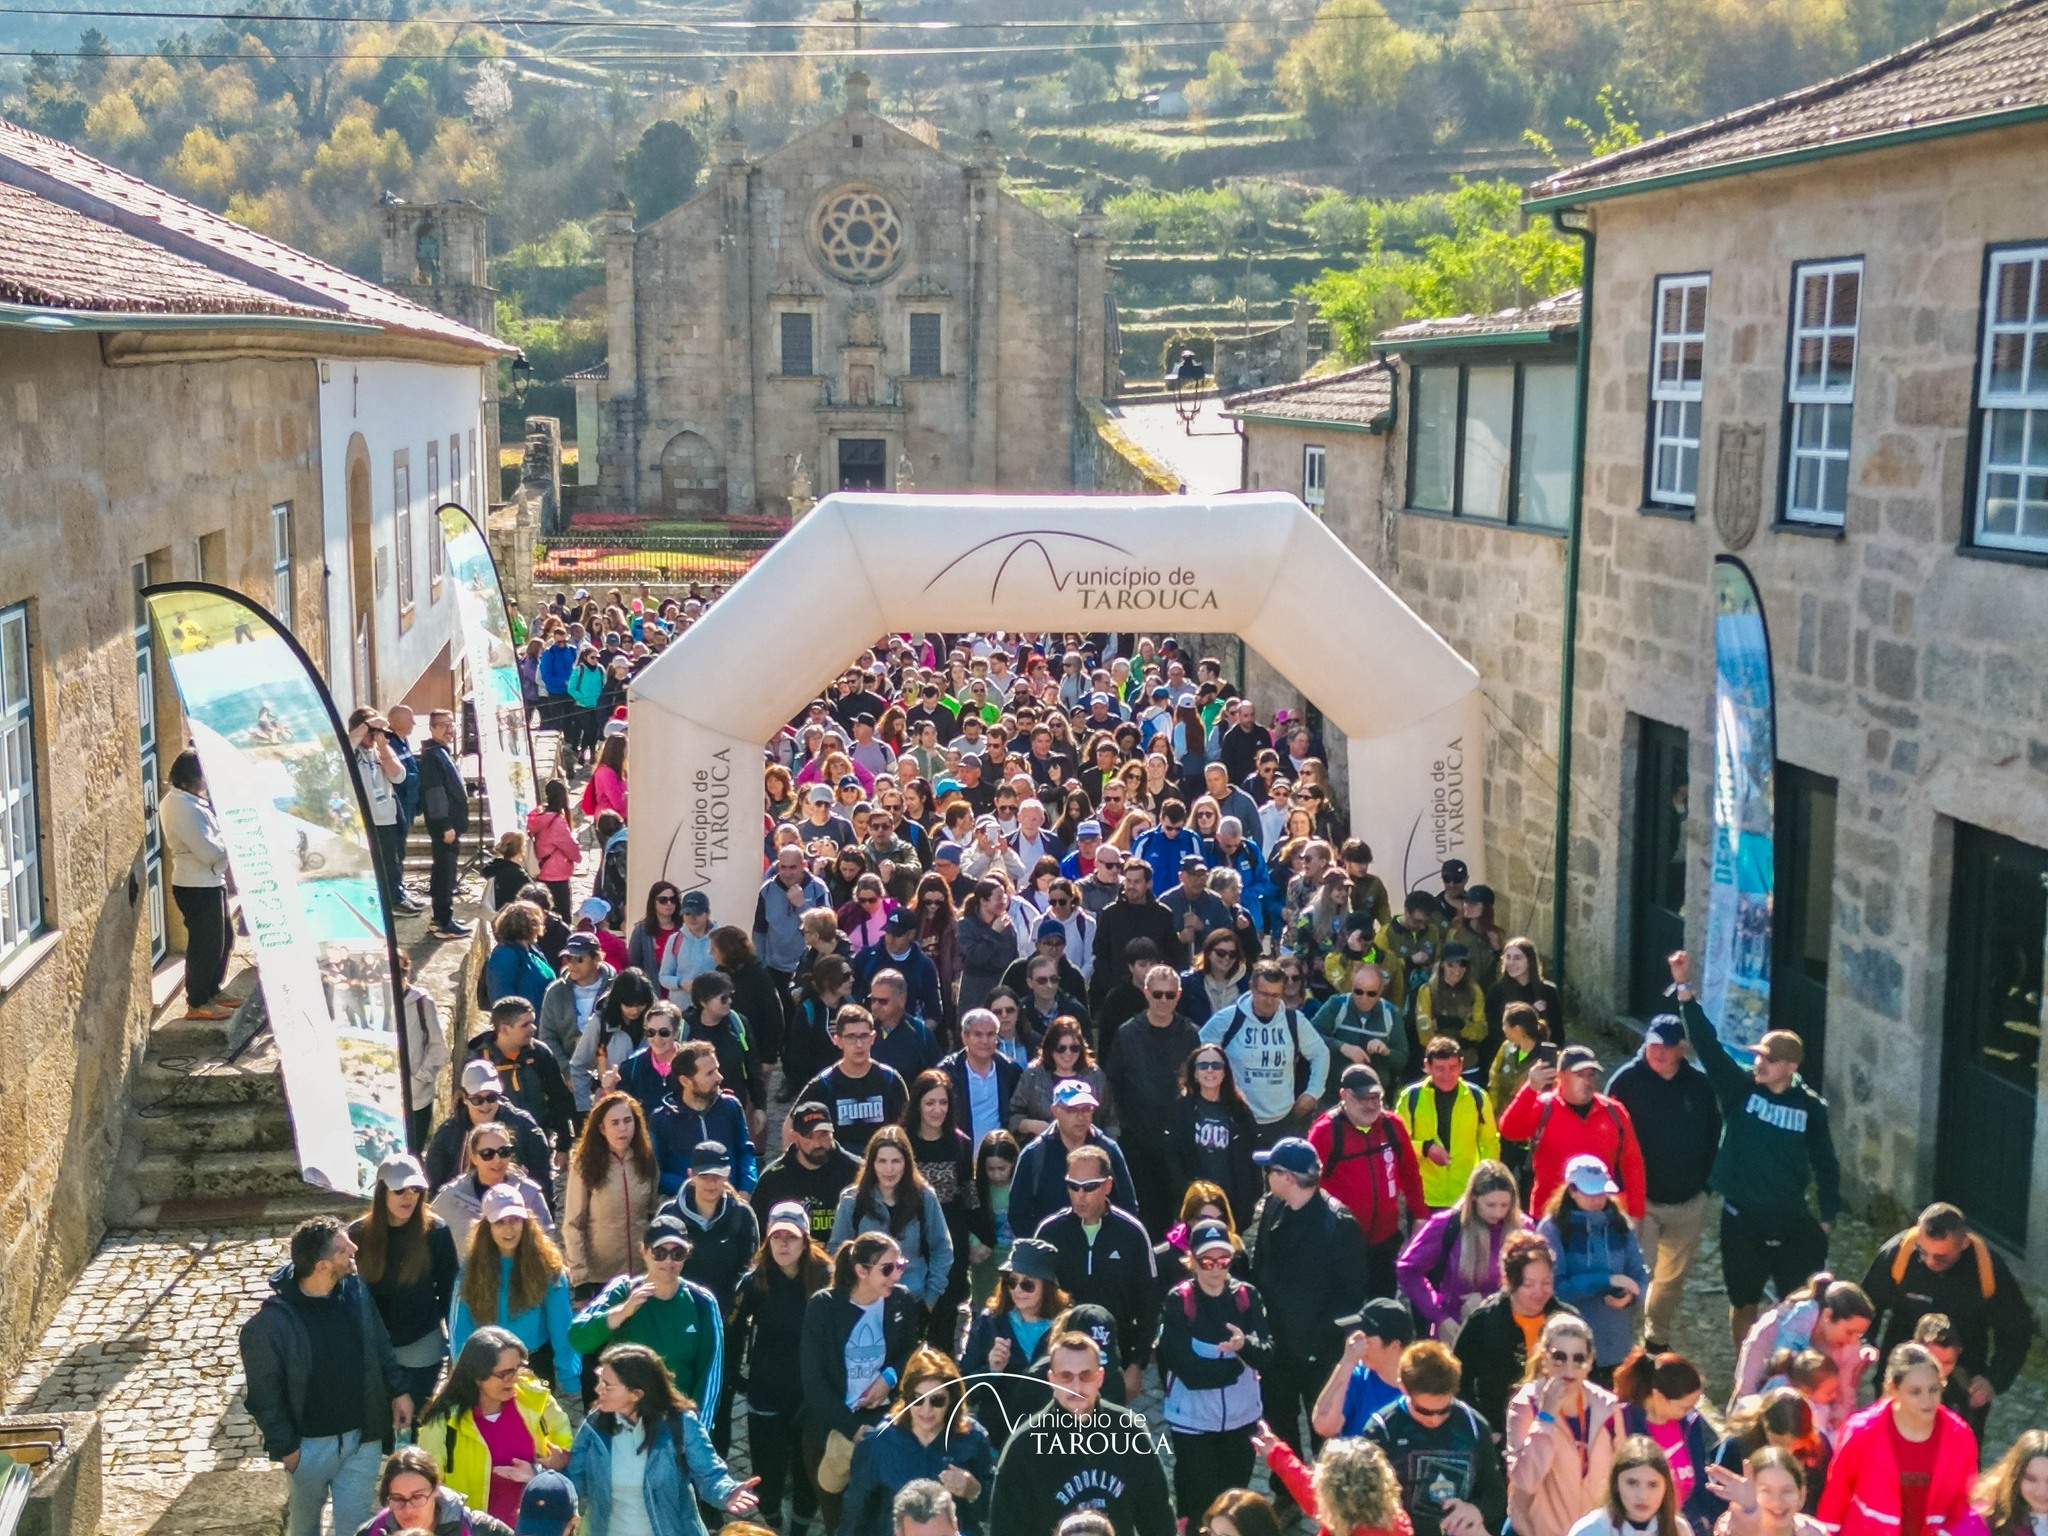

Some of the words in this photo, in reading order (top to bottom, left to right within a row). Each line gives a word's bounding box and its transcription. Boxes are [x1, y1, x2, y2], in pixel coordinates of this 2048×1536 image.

[1168, 566, 1196, 586] de
[1077, 588, 1219, 610] TAROUCA
[692, 770, 708, 792] de
[1430, 760, 1446, 783] de
[1447, 736, 1465, 852] TAROUCA
[710, 747, 731, 867] TAROUCA
[837, 1102, 883, 1121] PUMA
[1745, 1093, 1808, 1132] PUMA
[1055, 1468, 1126, 1506] BROOKLYN
